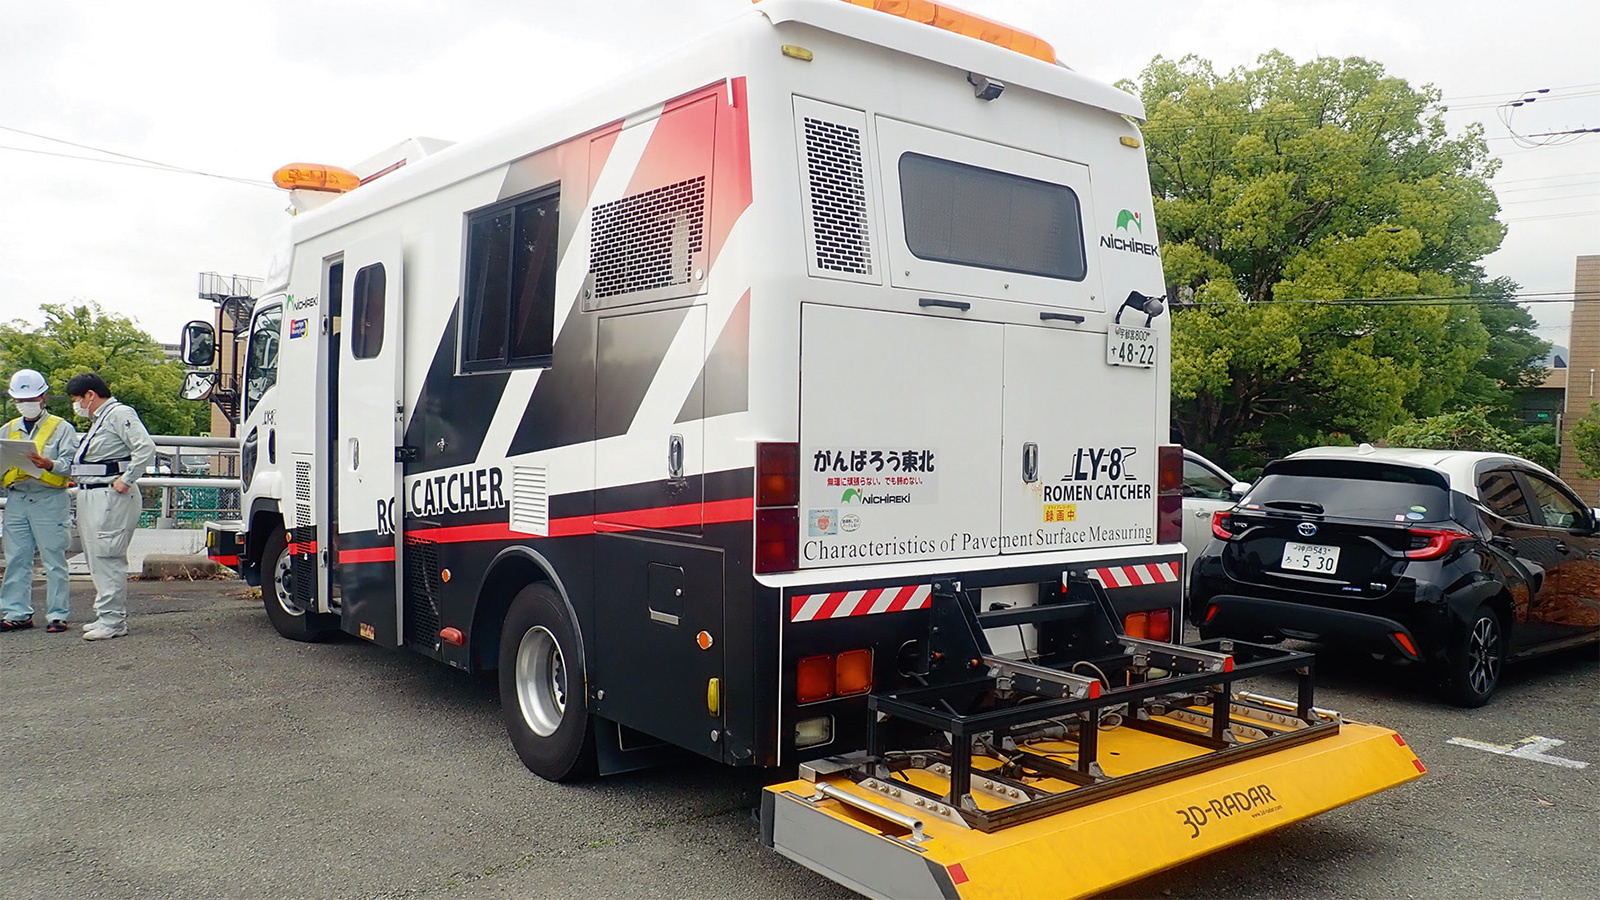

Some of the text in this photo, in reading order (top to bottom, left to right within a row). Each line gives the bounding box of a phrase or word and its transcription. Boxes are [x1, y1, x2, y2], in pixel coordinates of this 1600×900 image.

[1119, 342, 1155, 365] 48-22
[813, 449, 935, 473] がんばろう東北
[1074, 448, 1122, 481] LY-8
[410, 466, 505, 517] CATCHER
[1043, 484, 1152, 502] ROMEN CATCHER
[803, 523, 1153, 561] Characteristics of Pavement Surface Measuring
[1175, 784, 1277, 839] 3D-RADAR
